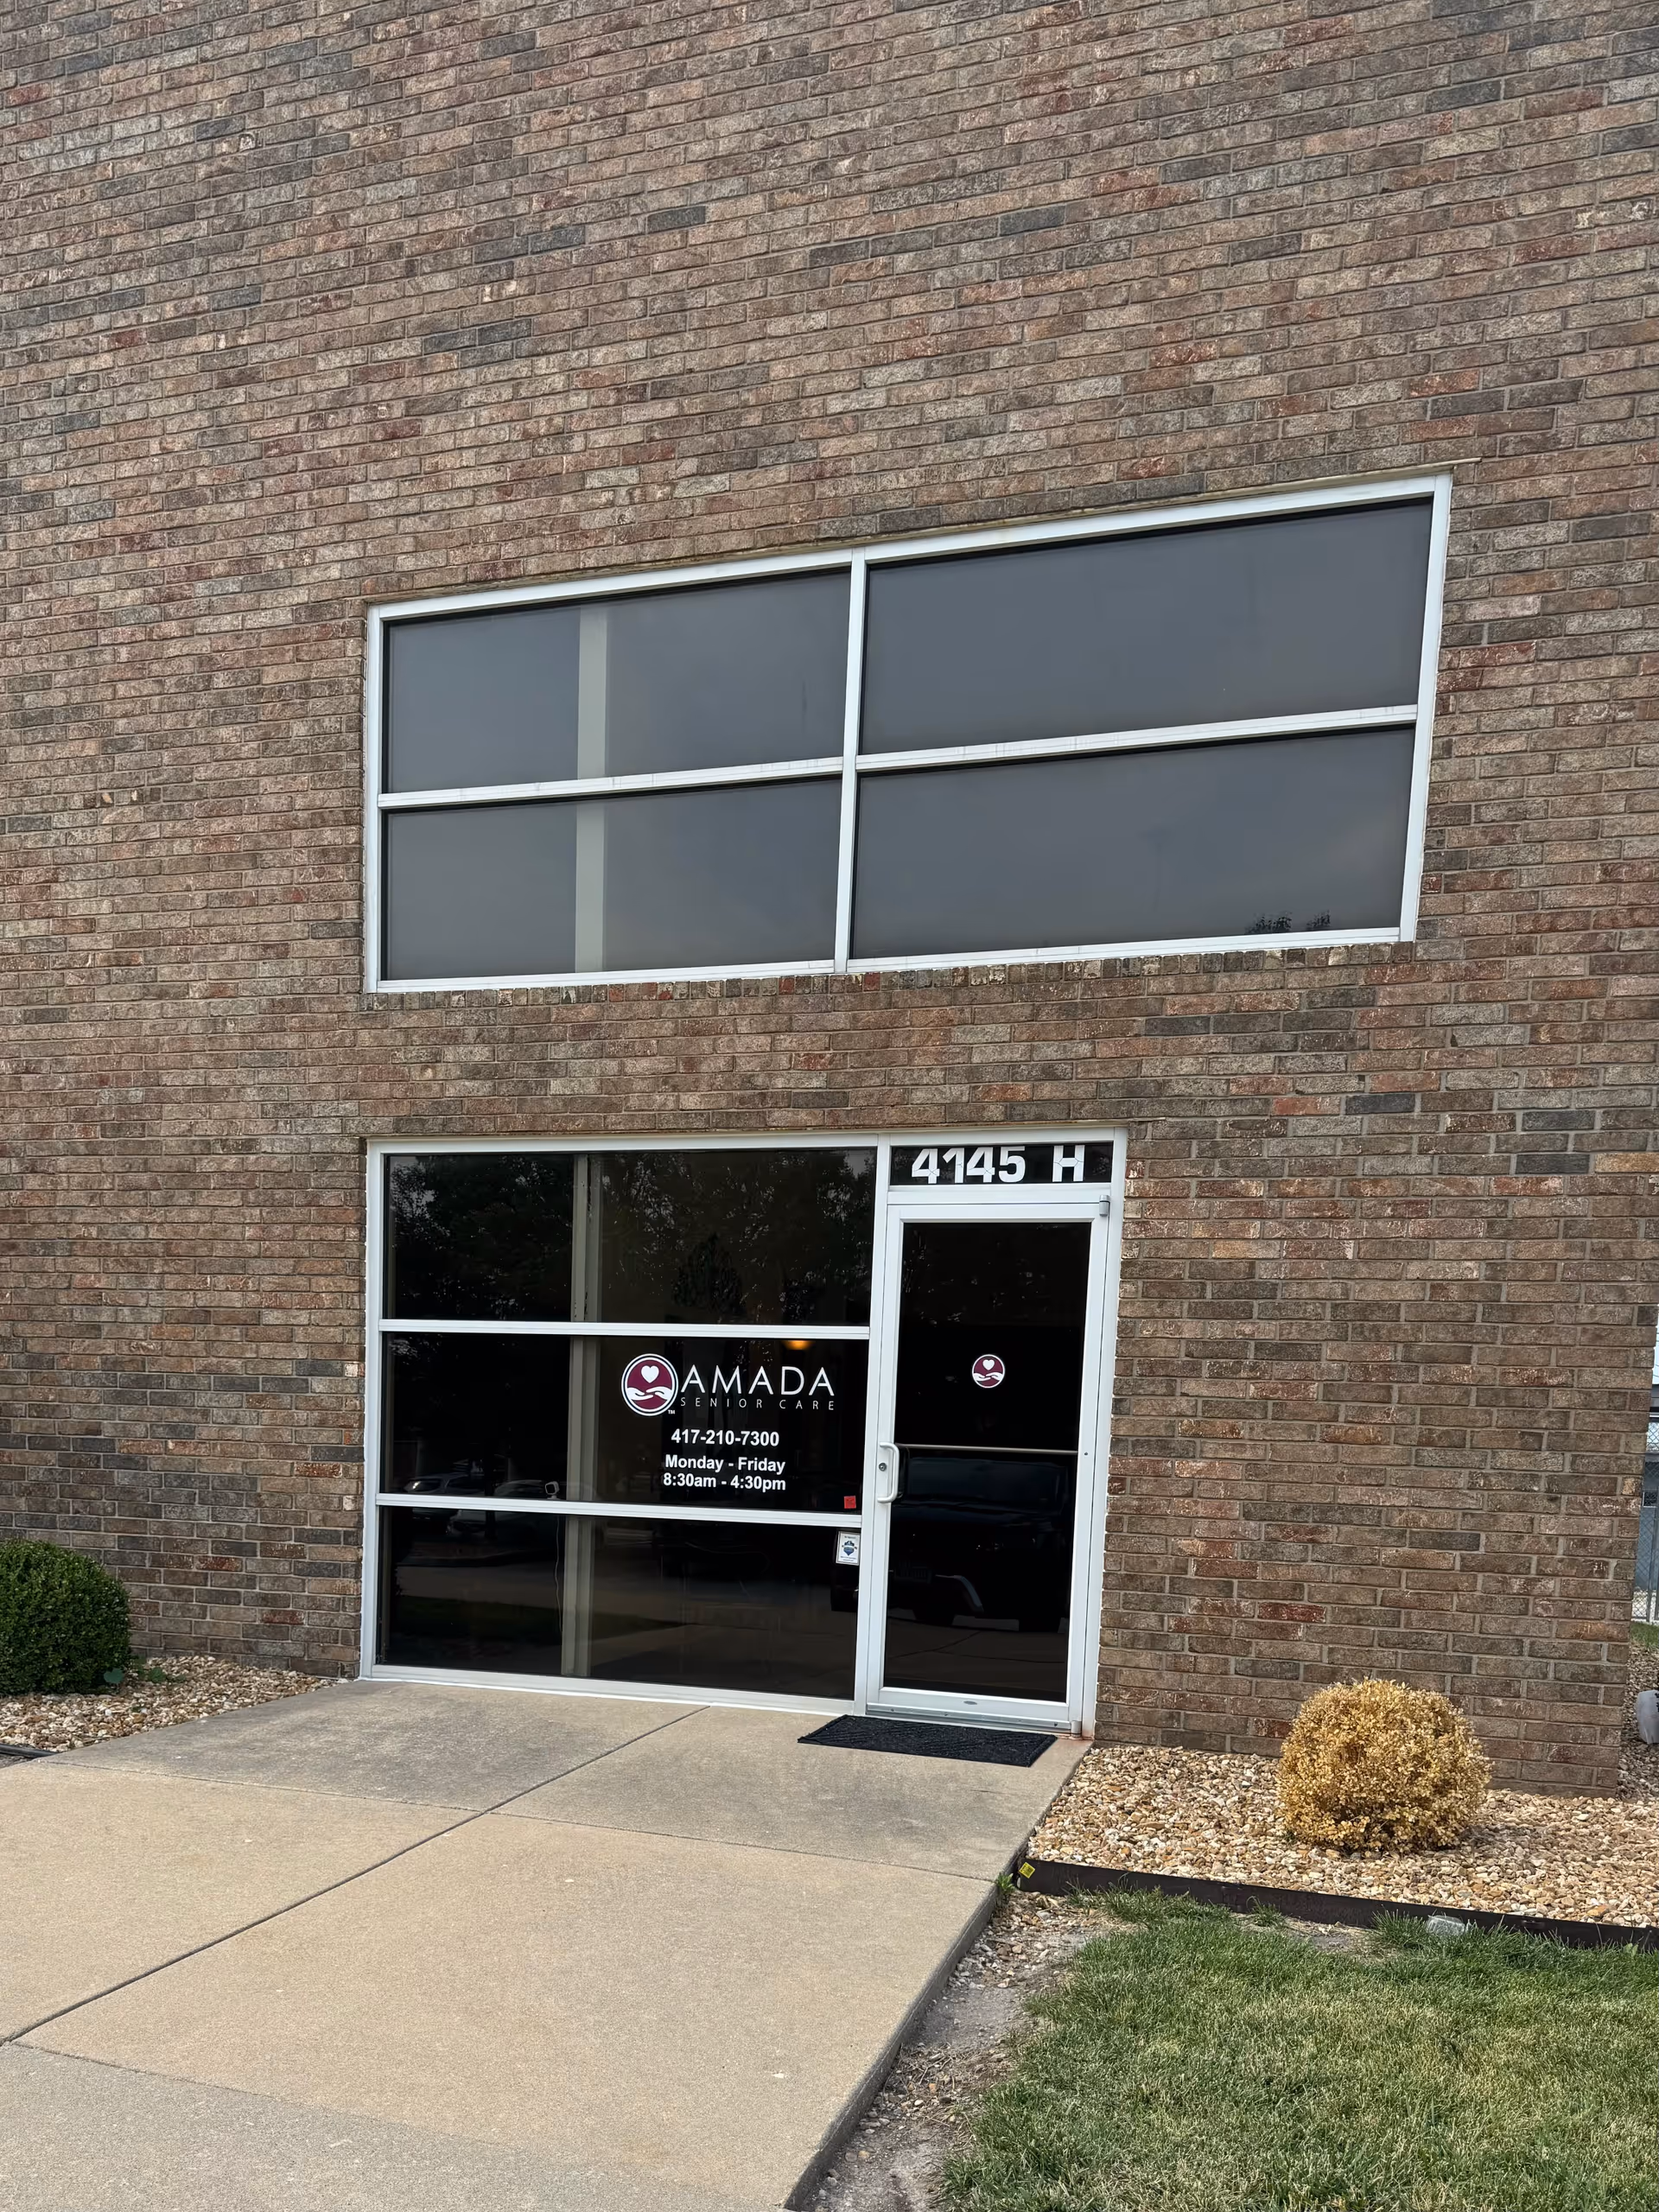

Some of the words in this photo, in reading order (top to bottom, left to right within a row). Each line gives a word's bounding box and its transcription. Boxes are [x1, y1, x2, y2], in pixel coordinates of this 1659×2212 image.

[912, 1146, 1026, 1184] 4145
[1052, 1144, 1085, 1182] H
[681, 1364, 835, 1396] AMADA
[681, 1397, 762, 1408] SENIOR
[779, 1399, 834, 1410] CARE
[671, 1428, 779, 1446] 417-210-7300
[665, 1454, 724, 1472] Monday
[738, 1457, 785, 1475] Friday
[663, 1473, 716, 1487] 8:30am
[730, 1475, 786, 1492] 4:30pm
